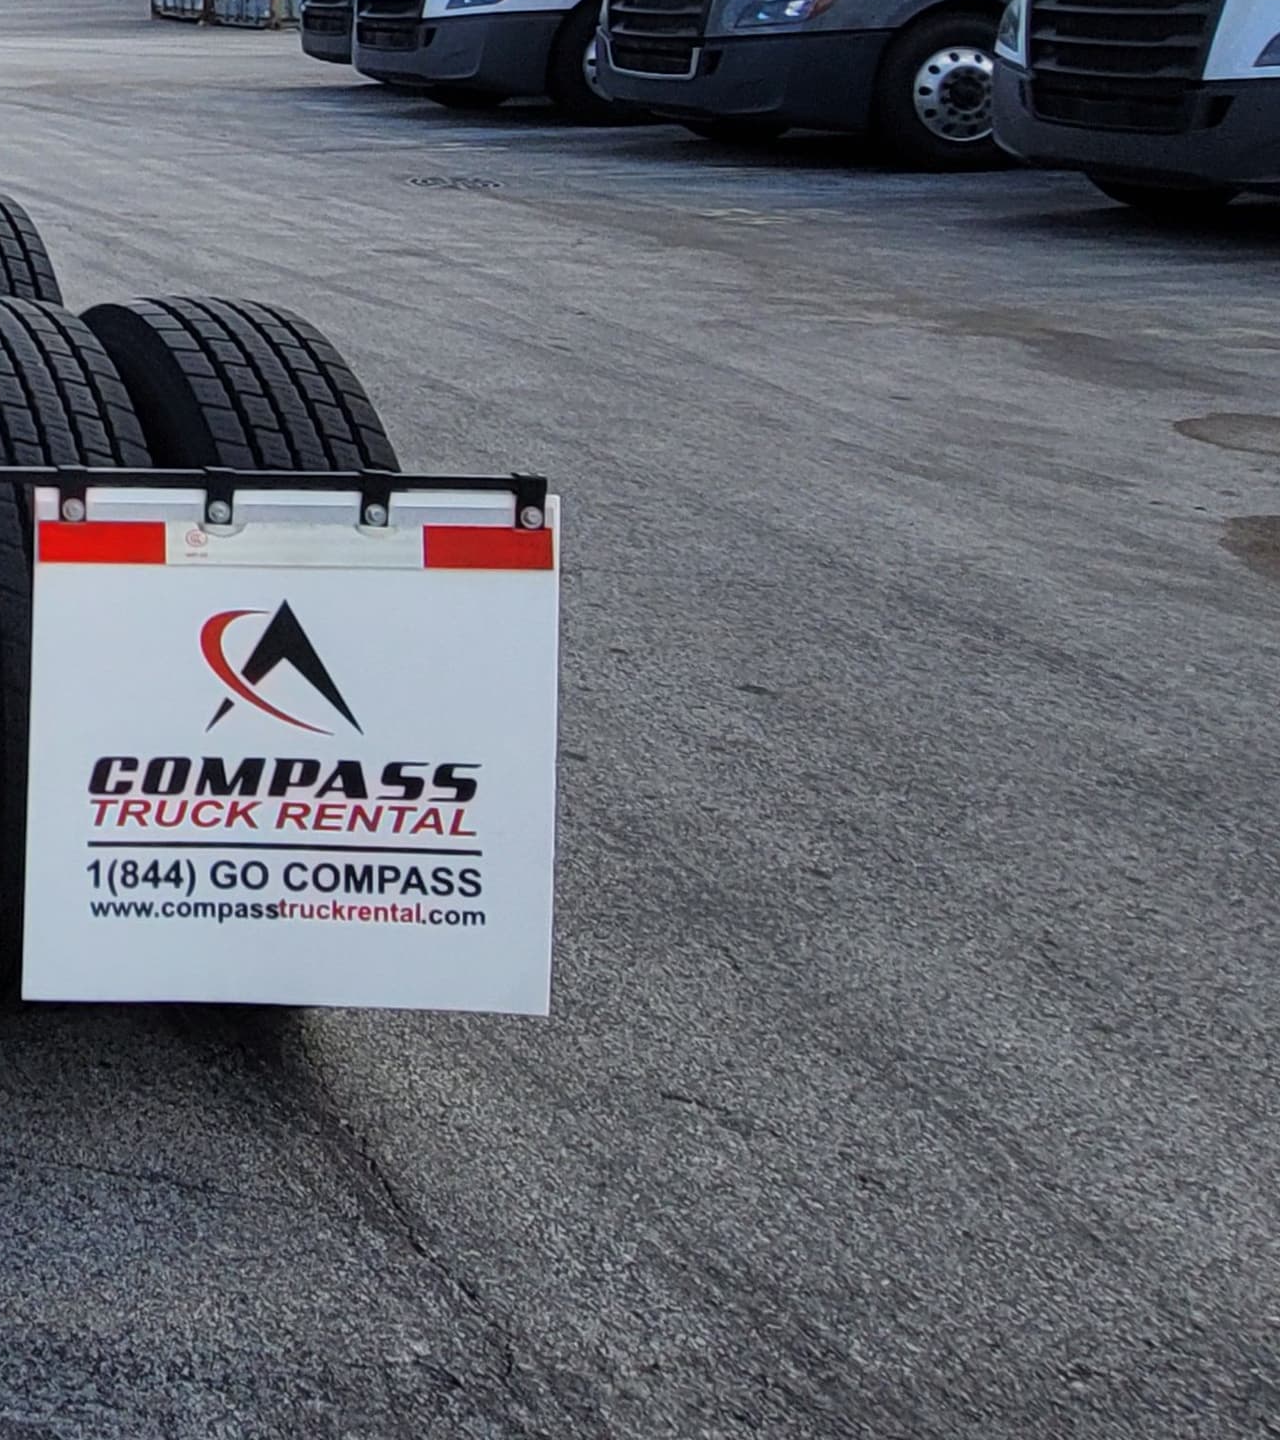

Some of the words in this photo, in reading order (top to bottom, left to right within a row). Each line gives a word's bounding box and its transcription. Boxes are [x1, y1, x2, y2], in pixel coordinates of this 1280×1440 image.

[88, 756, 482, 803] COMPASS
[89, 799, 263, 829] TRUCK
[275, 802, 477, 836] RENTAL
[87, 859, 197, 898] 1(844)
[209, 860, 270, 890] GO
[283, 862, 482, 898] COMPASS
[90, 899, 486, 926] www.compasstruckrental.com
